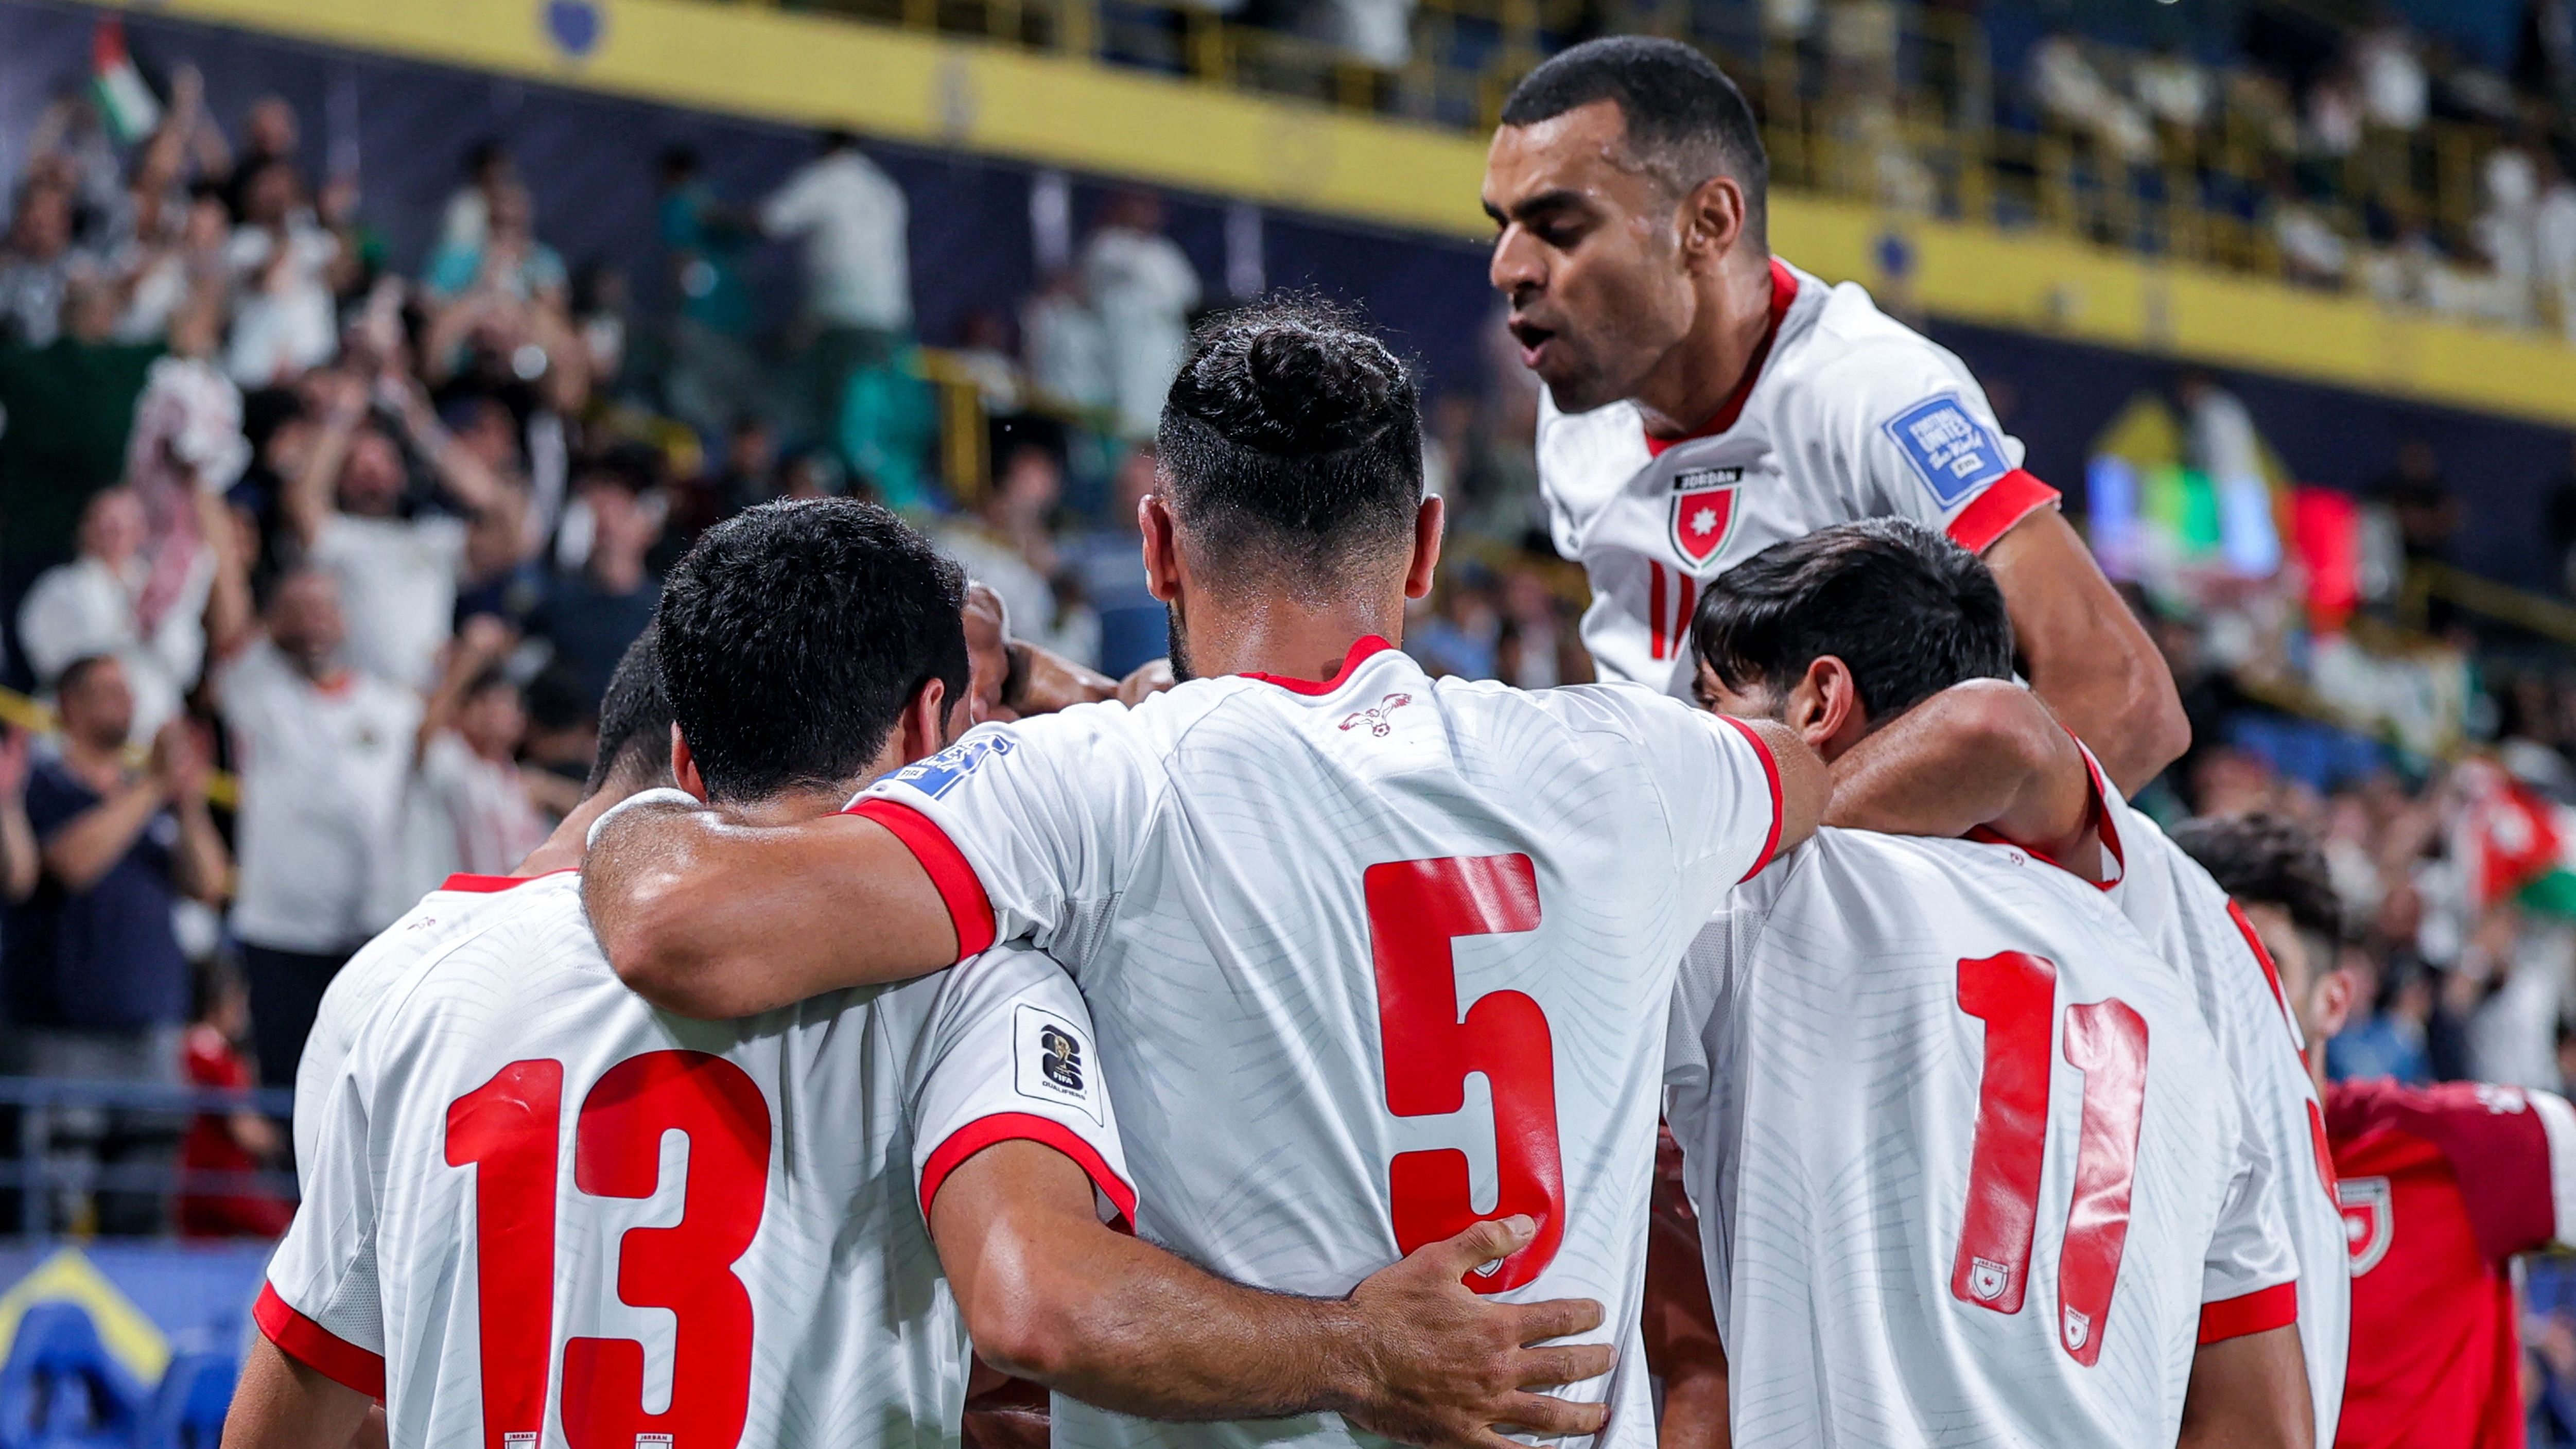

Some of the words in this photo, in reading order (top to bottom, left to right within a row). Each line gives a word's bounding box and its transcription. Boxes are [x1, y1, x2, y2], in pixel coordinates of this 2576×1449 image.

[1682, 470, 1736, 489] JORDAN
[1042, 1081, 1086, 1101] QUALIFIERS
[1053, 1071, 1073, 1085] FIFA
[1363, 852, 1565, 1295] 5
[1951, 950, 2149, 1368] 11
[443, 1049, 772, 1449] 13
